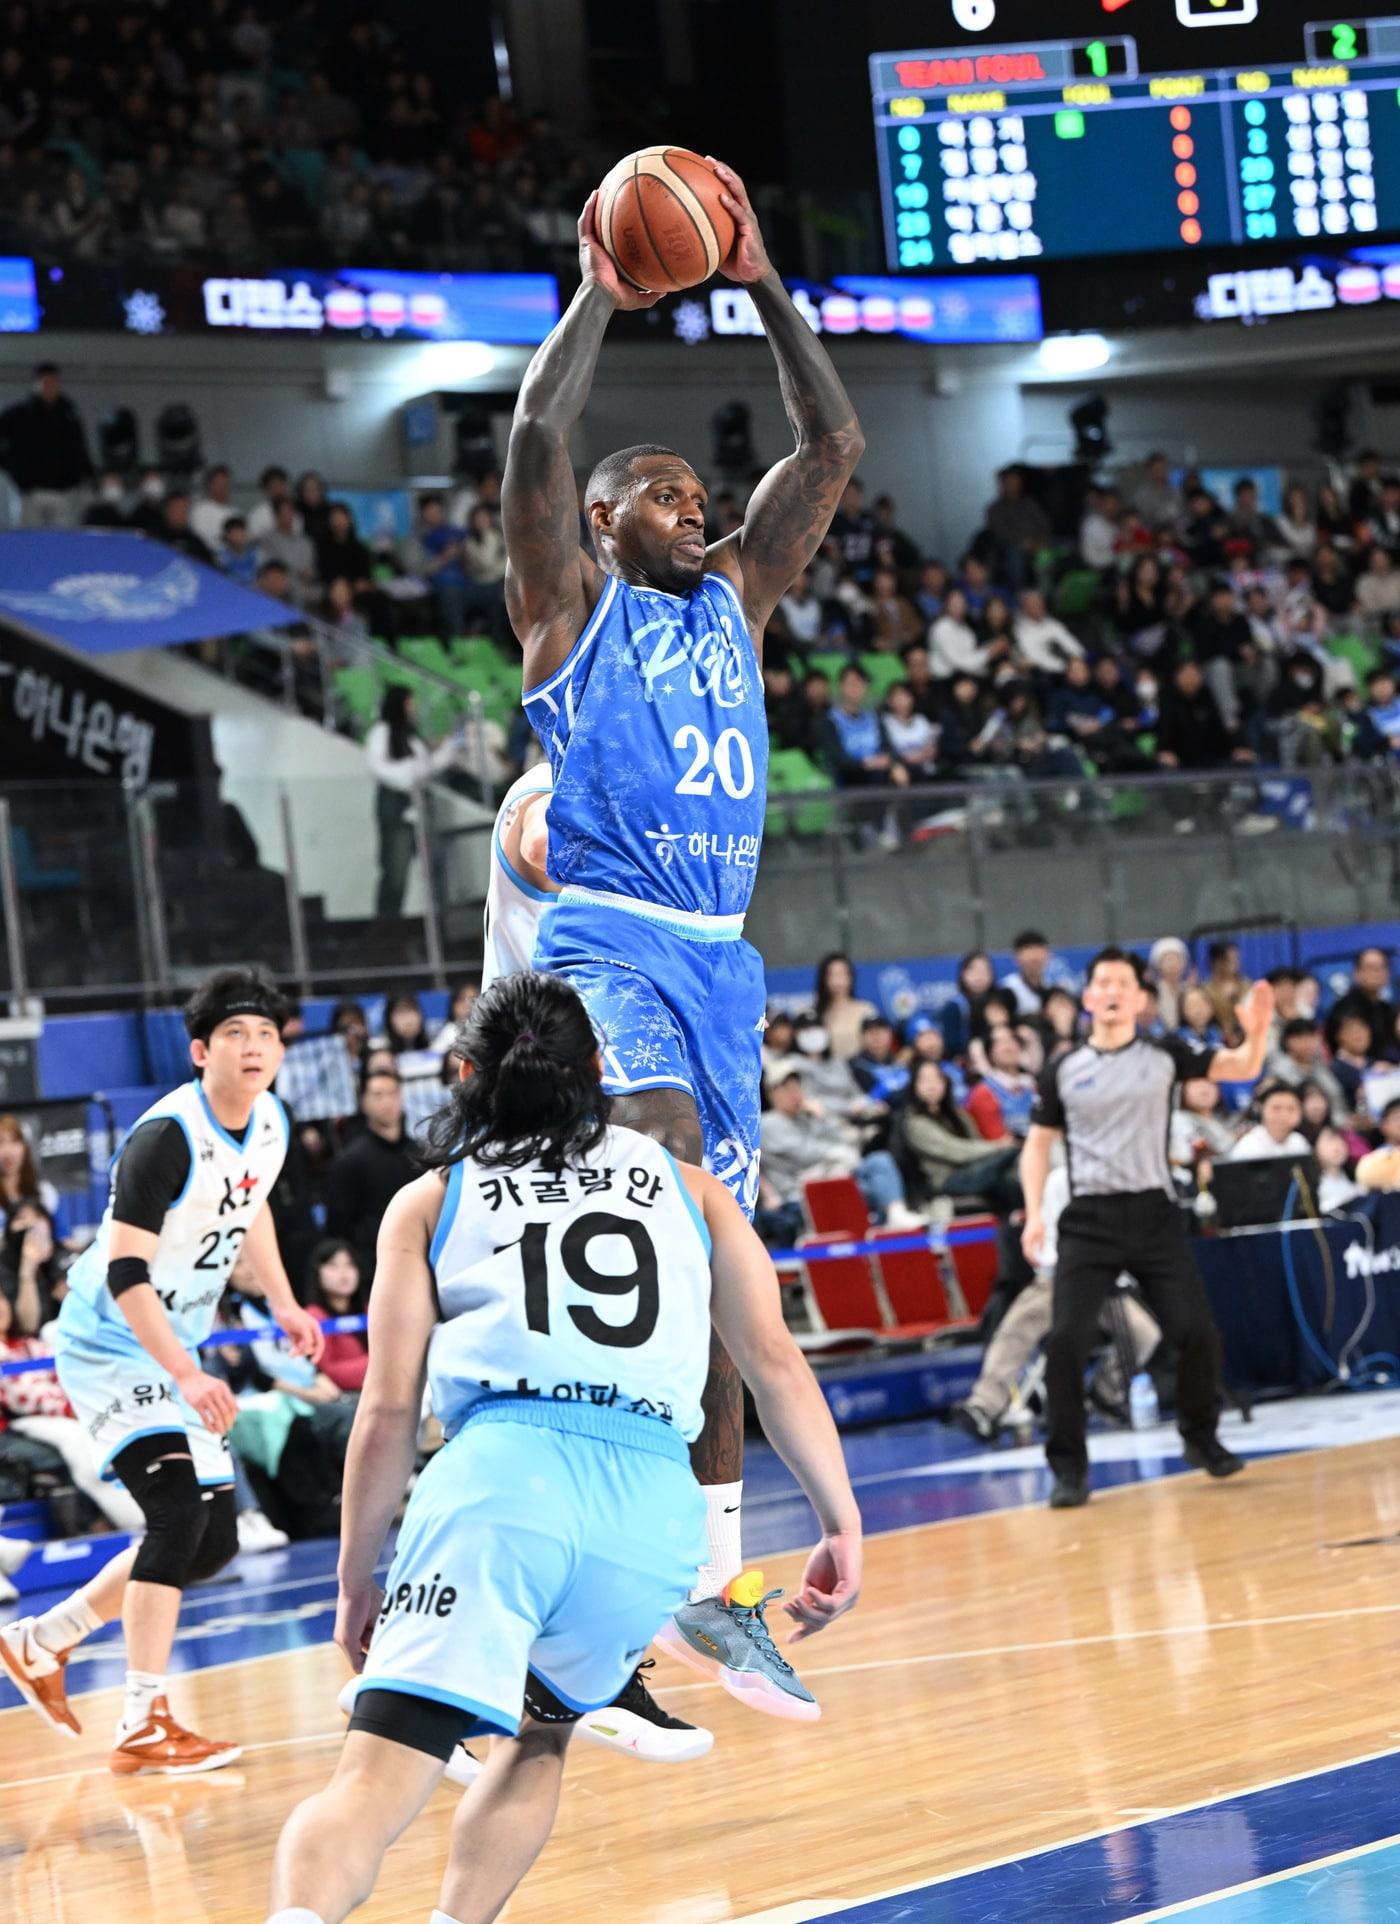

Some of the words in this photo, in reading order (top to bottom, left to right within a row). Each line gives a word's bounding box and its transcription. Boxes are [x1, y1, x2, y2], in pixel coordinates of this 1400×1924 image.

[1086, 41, 1108, 77] 1
[1332, 24, 1357, 59] 2
[673, 724, 755, 800] 20
[494, 1211, 660, 1348] 19
